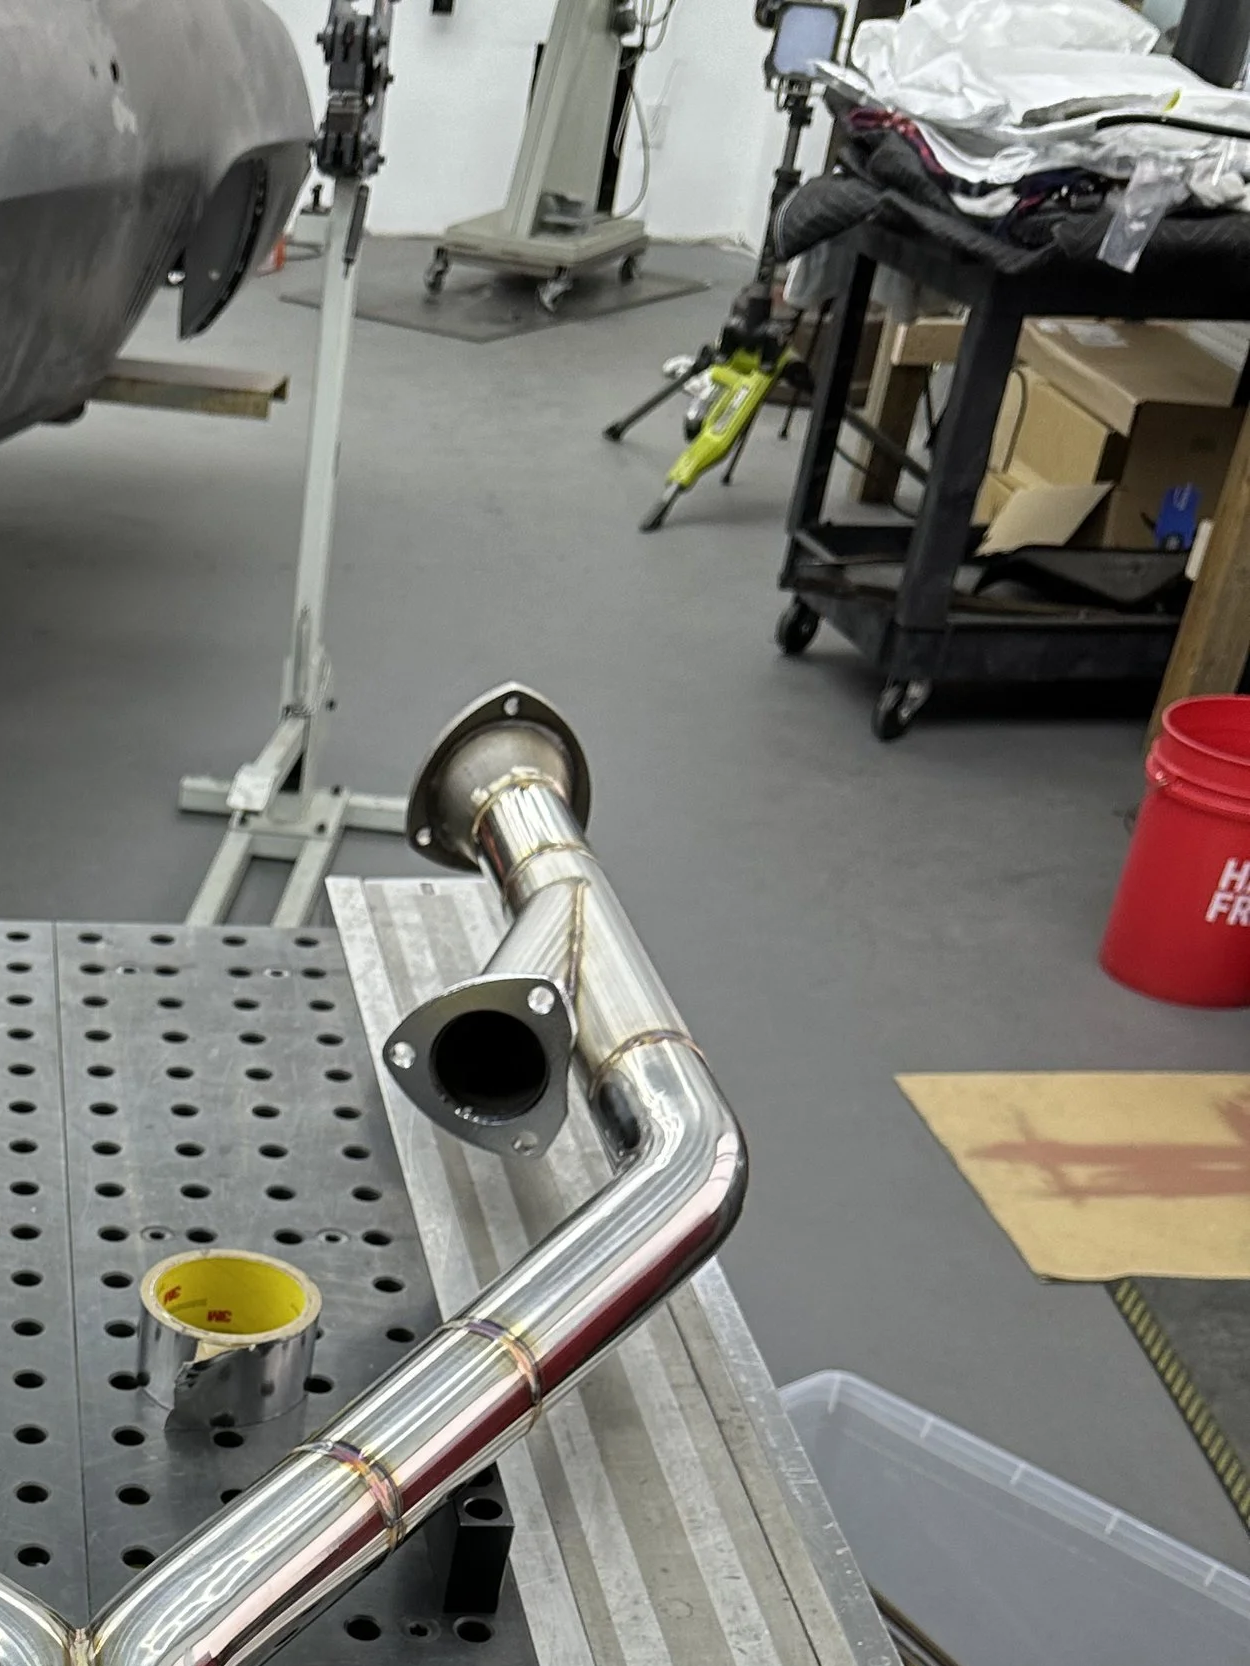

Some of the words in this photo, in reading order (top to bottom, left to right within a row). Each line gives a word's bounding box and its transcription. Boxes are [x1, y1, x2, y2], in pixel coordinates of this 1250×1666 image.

[1218, 857, 1250, 892] H
[163, 1284, 182, 1305] 3M
[207, 1310, 232, 1323] 3M
